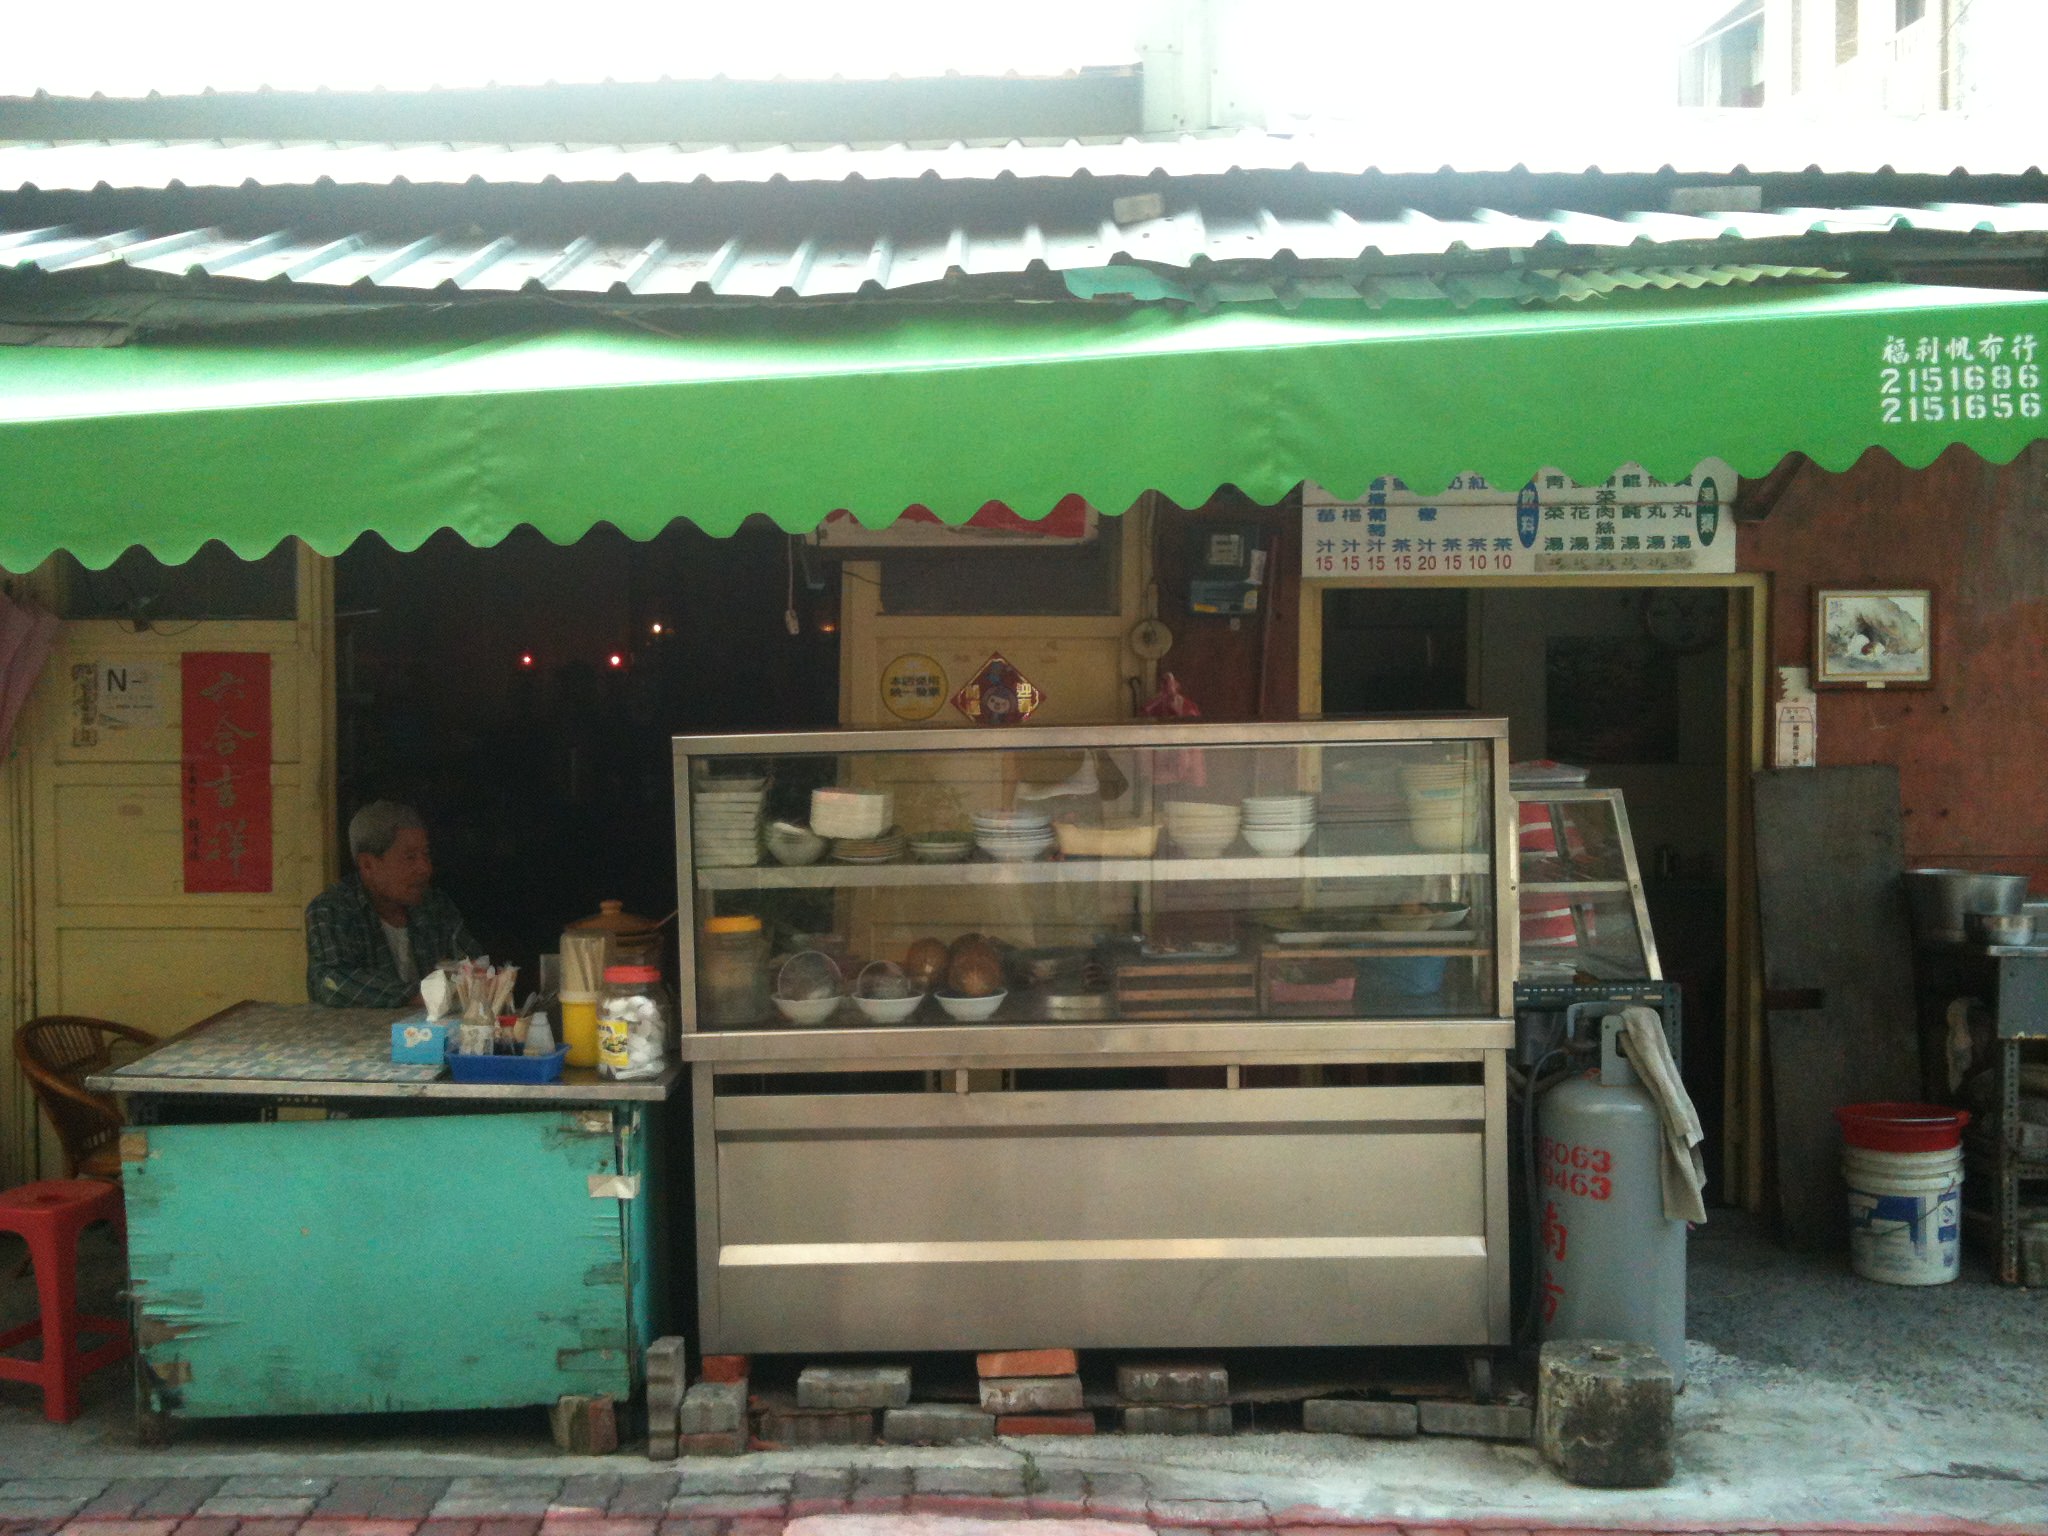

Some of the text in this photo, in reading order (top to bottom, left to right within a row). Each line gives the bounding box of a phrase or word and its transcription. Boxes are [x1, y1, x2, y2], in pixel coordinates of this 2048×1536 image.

[1881, 333, 2038, 364] 福利帆布行
[1880, 363, 2039, 394] 2151686
[1880, 392, 2041, 423] 2151656
[1316, 555, 1333, 571] 15
[1343, 555, 1360, 571] 15
[1368, 555, 1385, 571] 15
[1394, 555, 1411, 571] 15
[1418, 555, 1436, 570] 20
[1444, 555, 1462, 570] 15
[1469, 554, 1487, 570] 10
[1494, 554, 1512, 570] 10
[1540, 1136, 1611, 1174] 5063
